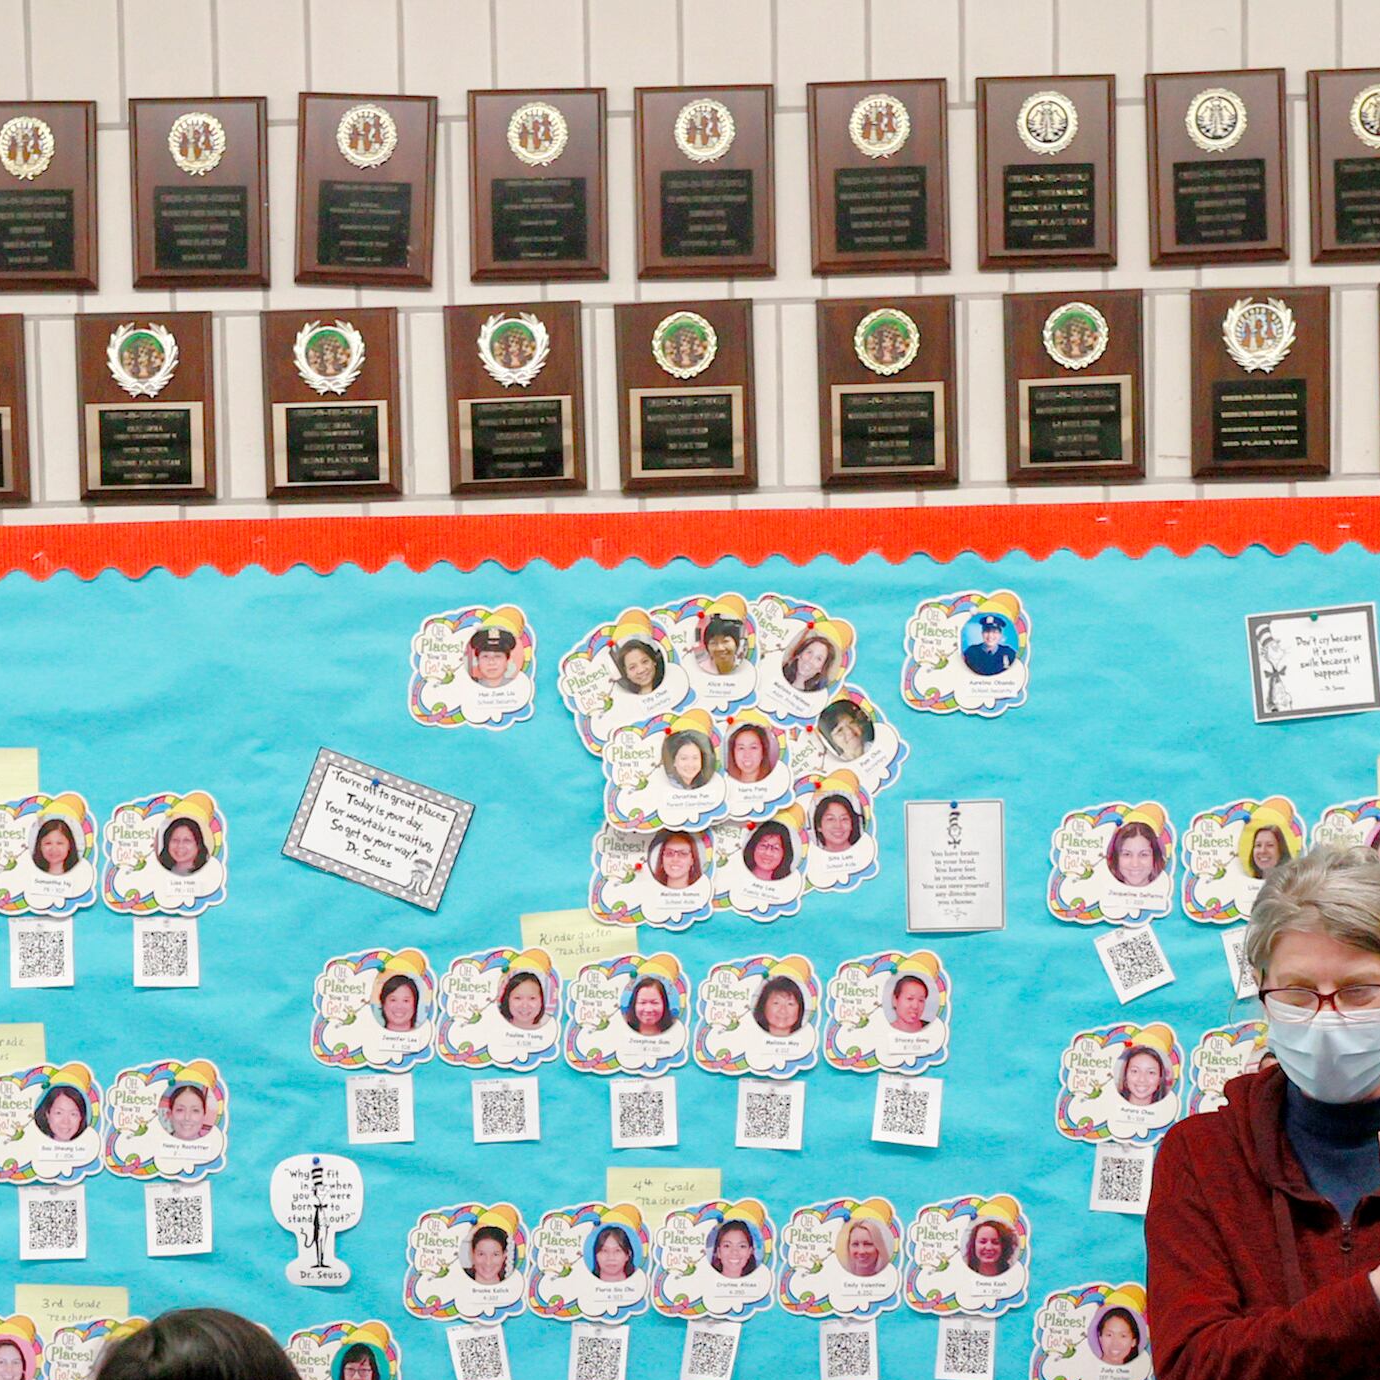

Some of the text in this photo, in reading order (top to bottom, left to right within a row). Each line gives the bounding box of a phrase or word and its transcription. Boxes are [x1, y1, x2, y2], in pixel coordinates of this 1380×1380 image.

[421, 638, 464, 654] Places!
[1295, 634, 1362, 646] Don't cry because
[424, 660, 441, 673] Go!
[1320, 656, 1351, 666] because
[612, 746, 655, 760] Places!
[617, 768, 633, 783] Go!
[379, 789, 389, 801] to
[390, 794, 416, 812] great
[325, 800, 345, 816] Your
[346, 811, 387, 836] mountain
[388, 824, 397, 837] is
[346, 792, 425, 832] Today is your day.
[330, 818, 344, 832] So
[345, 825, 361, 838] get
[362, 833, 374, 844] on
[373, 837, 393, 853] your
[1061, 834, 1103, 848] Places!
[345, 840, 393, 869] Dr. Seuss
[1063, 855, 1079, 869] Go!
[555, 945, 601, 955] Teachers
[323, 978, 366, 995] Places!
[326, 1000, 342, 1014] Go!
[326, 1169, 339, 1178] fit
[633, 1178, 696, 1192] 4th Grade
[292, 1193, 310, 1202] you
[635, 1197, 686, 1206] Teachers
[291, 1203, 340, 1211] born to
[287, 1214, 313, 1223] stand
[416, 1233, 459, 1248] Places!
[789, 1229, 832, 1244] Places!
[419, 1254, 436, 1267] Go!
[792, 1251, 809, 1265] Go!
[300, 1271, 343, 1279] Dr. Seuss
[42, 1298, 102, 1309] 3rd Grade
[1043, 1313, 1086, 1328] Places!
[1046, 1334, 1063, 1348] Go!
